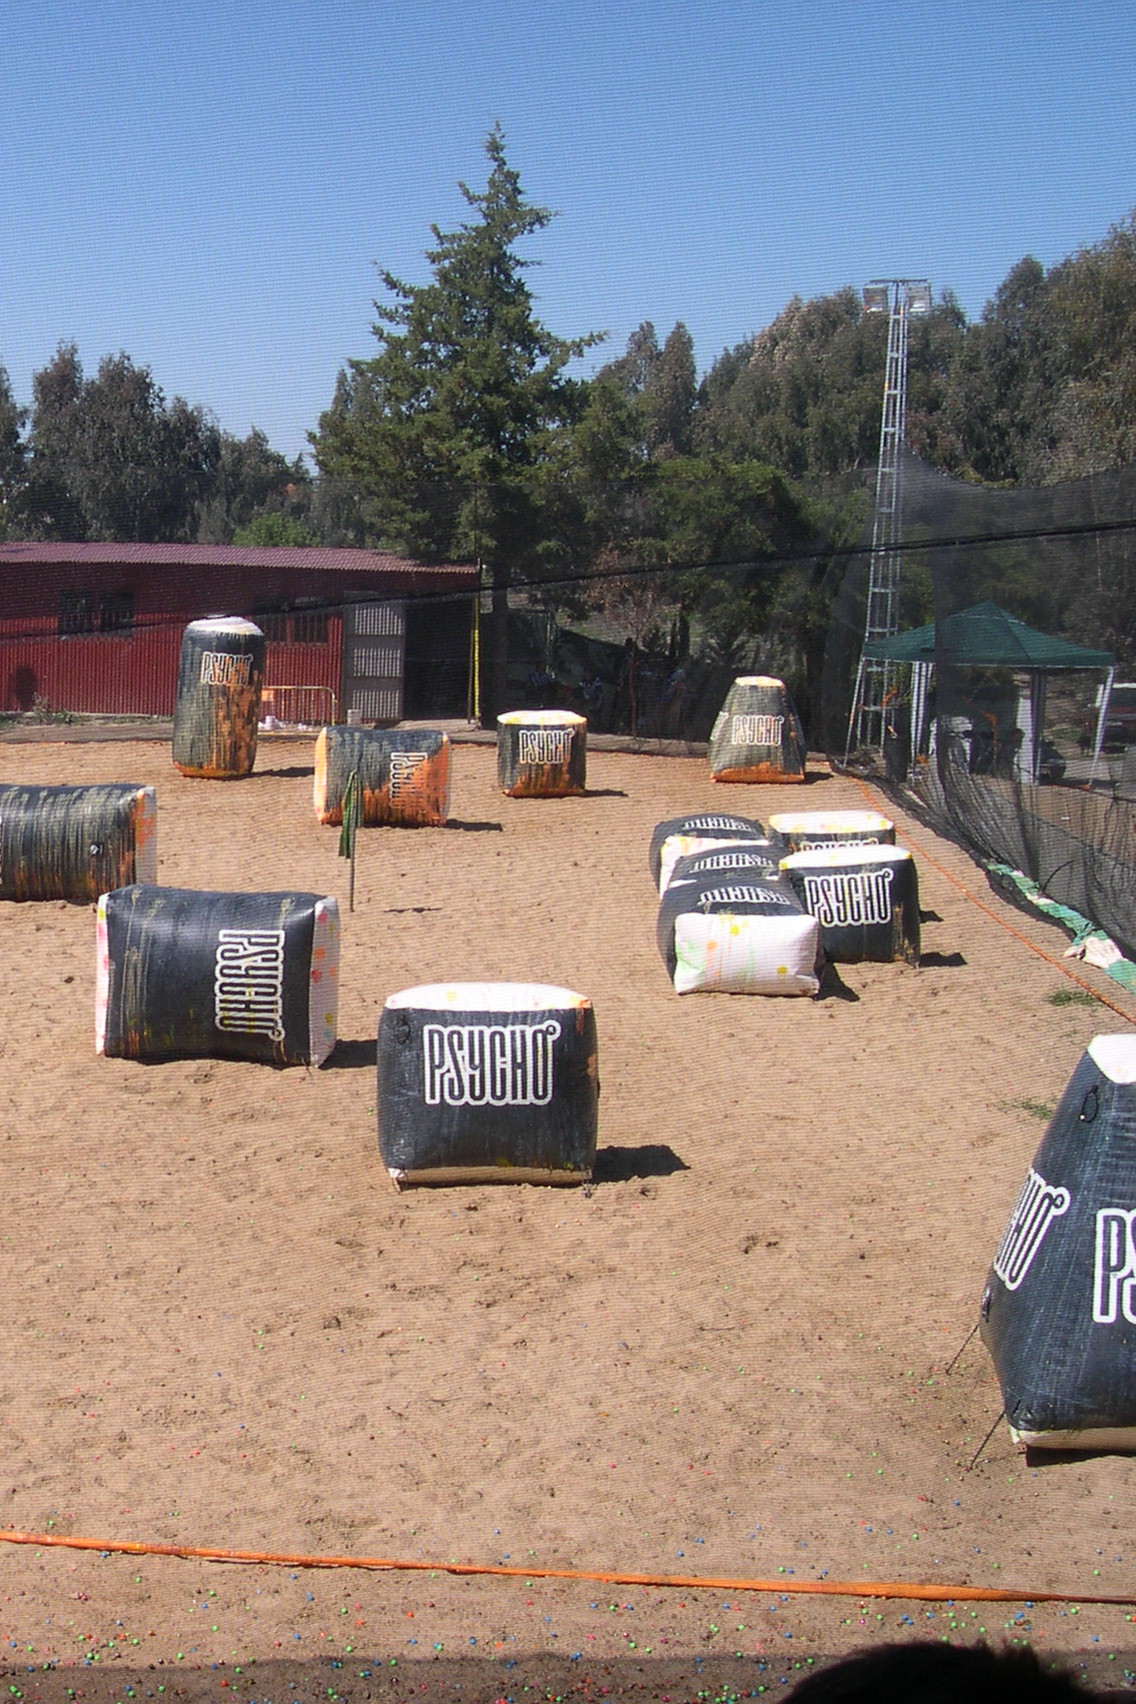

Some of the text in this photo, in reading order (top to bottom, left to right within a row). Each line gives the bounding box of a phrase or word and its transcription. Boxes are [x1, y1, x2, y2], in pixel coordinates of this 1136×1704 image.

[201, 651, 253, 685] PSYCHO
[519, 728, 575, 764] PSYCHO
[732, 715, 785, 746] PSYCHO
[389, 752, 429, 811] PSYC
[804, 868, 894, 928] PSYCHO
[214, 929, 286, 1042] PSYCHO
[422, 1020, 561, 1106] PSYCHO
